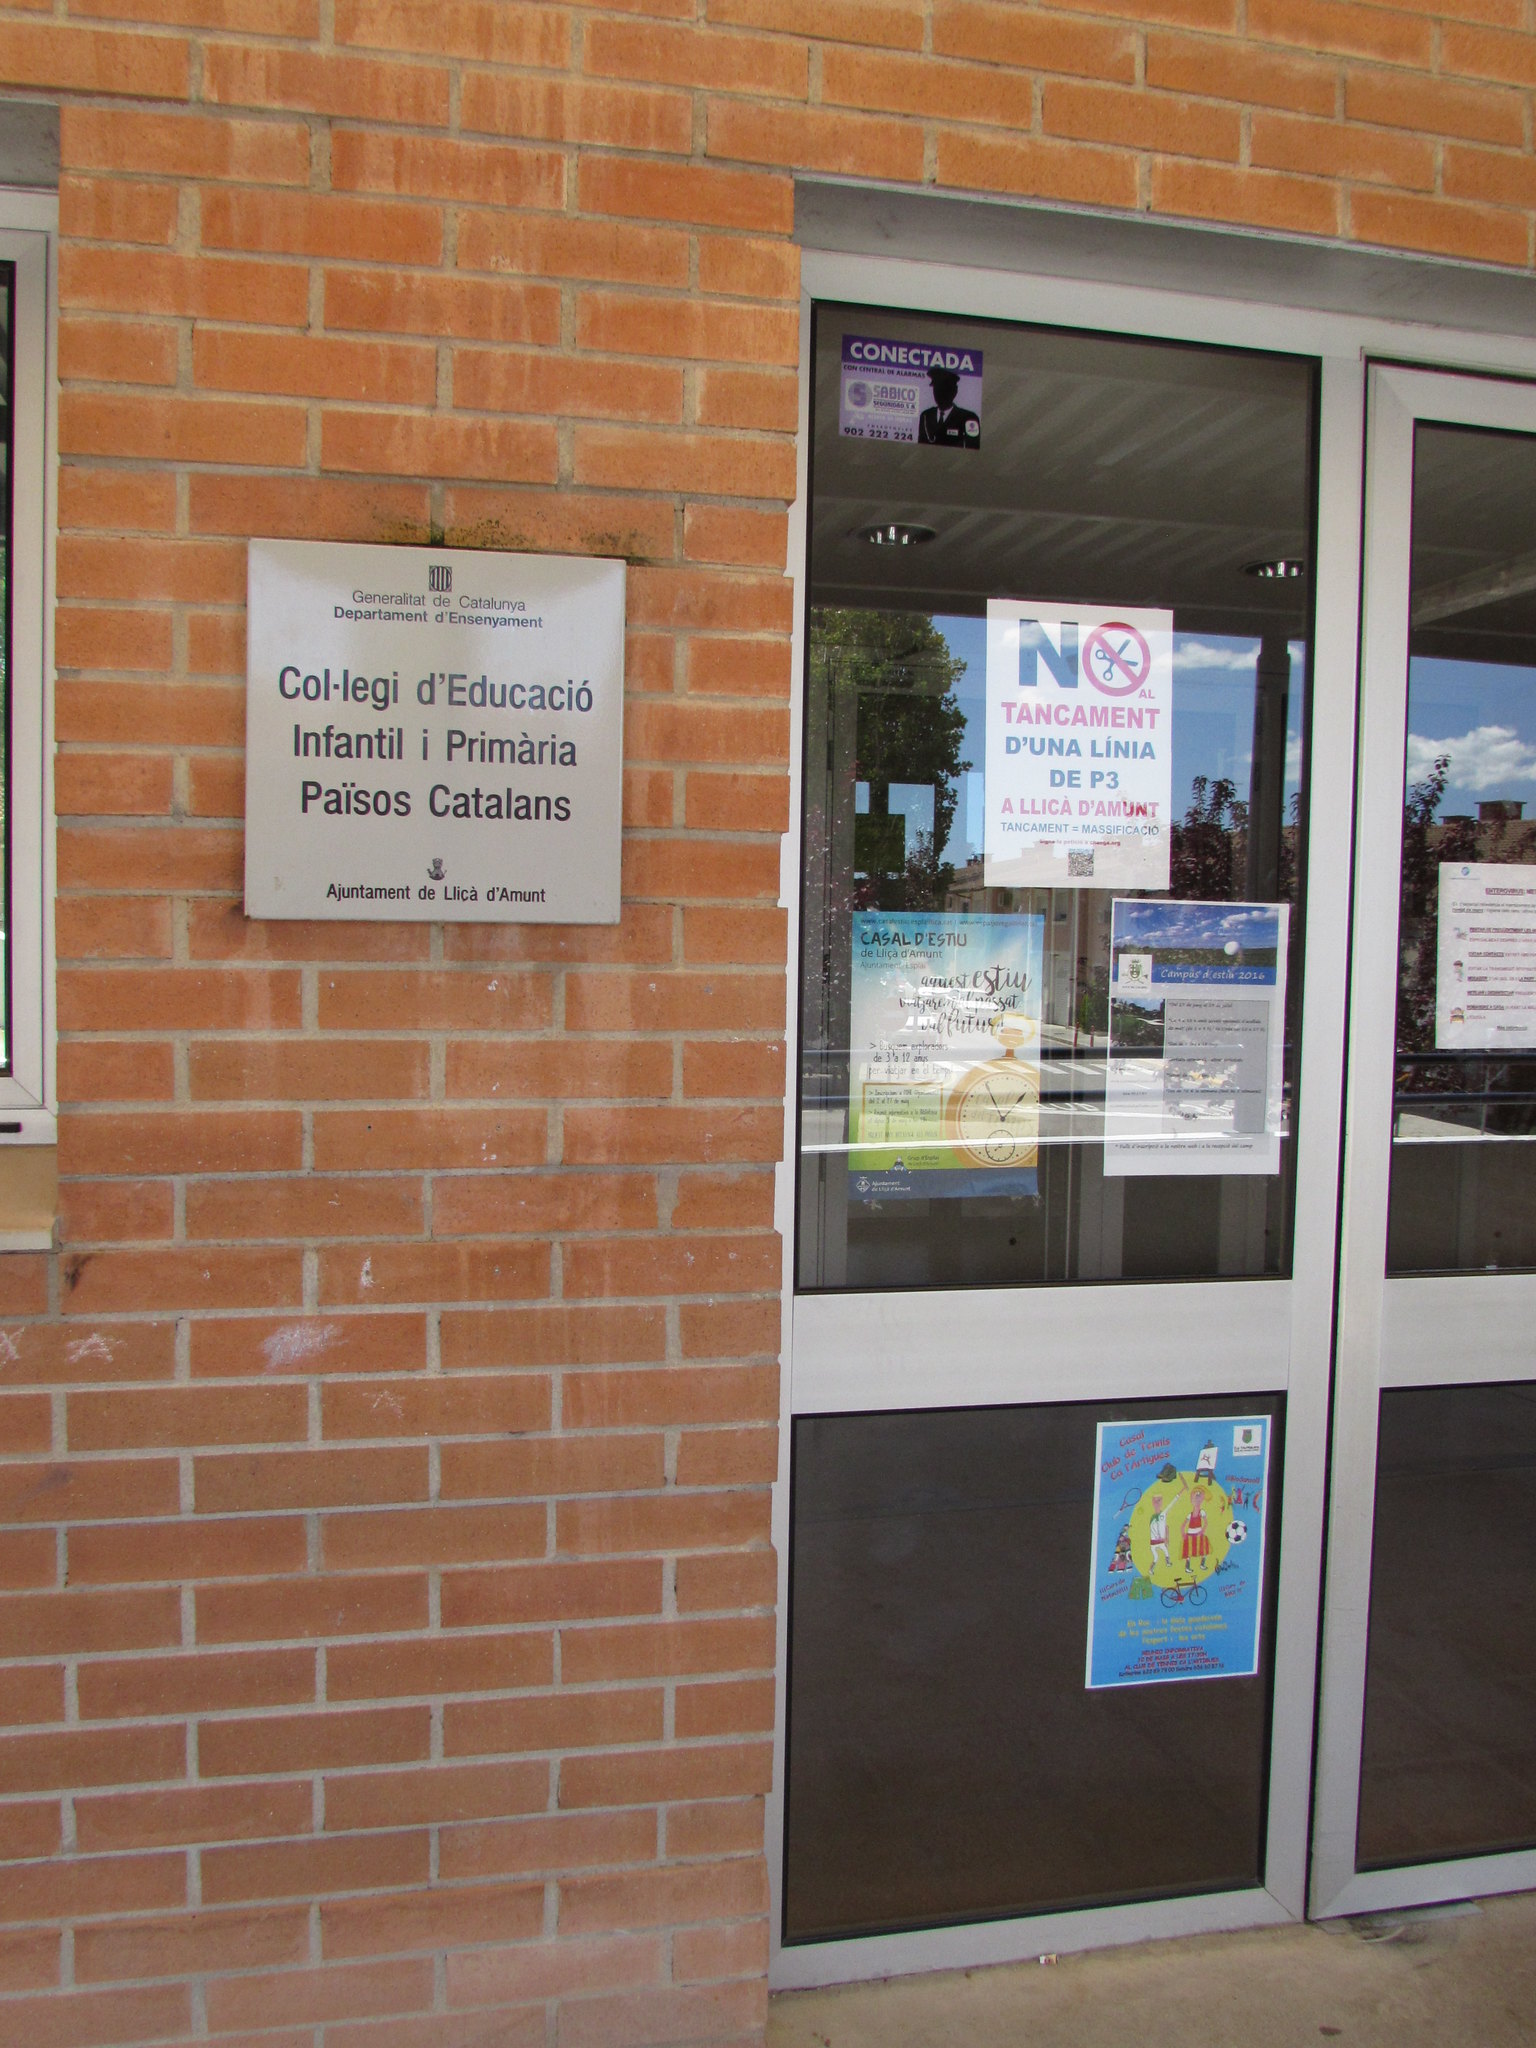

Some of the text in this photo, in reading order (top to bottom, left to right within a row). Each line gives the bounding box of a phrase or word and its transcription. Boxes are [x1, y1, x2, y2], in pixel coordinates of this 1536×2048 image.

[850, 342, 974, 372] CONECTADA
[860, 366, 885, 374] CENTRAL
[896, 370, 926, 378] ALARMAS
[873, 385, 916, 401] SABICO
[844, 427, 913, 441] 902 222 224
[352, 589, 526, 613] Generalitat de Catalunya
[334, 606, 543, 629] Departament d'Ensenyament
[416, 672, 594, 713] d'Educació
[1138, 688, 1156, 700] AL
[1001, 701, 1160, 730] TANCAMENT
[293, 724, 577, 767] Infantil i Primària
[1005, 735, 1156, 760] D'UNA LÍNIA
[1049, 769, 1119, 790] DE P3
[300, 780, 571, 822] Països Catalans
[1001, 797, 1014, 814] A
[1078, 799, 1160, 819] D'AMUNT
[1000, 822, 1069, 834] TANCAMENT
[1081, 822, 1160, 836] MASSIFICACIÓ
[326, 883, 546, 904] Ajuntament de Lliçà d'Amunt
[861, 932, 967, 948] CASAL D'ESTIU
[860, 948, 943, 960] de Lliçà d'Amunt
[921, 964, 1033, 996] aquest estiu
[1238, 971, 1265, 980] 2016
[873, 1052, 882, 1062] de
[886, 1052, 891, 1062] 3
[902, 1052, 910, 1062] 12
[1120, 1429, 1144, 1448] Casal
[1102, 1437, 1170, 1473] Club de Tennis
[1111, 1470, 1124, 1480] Ca
